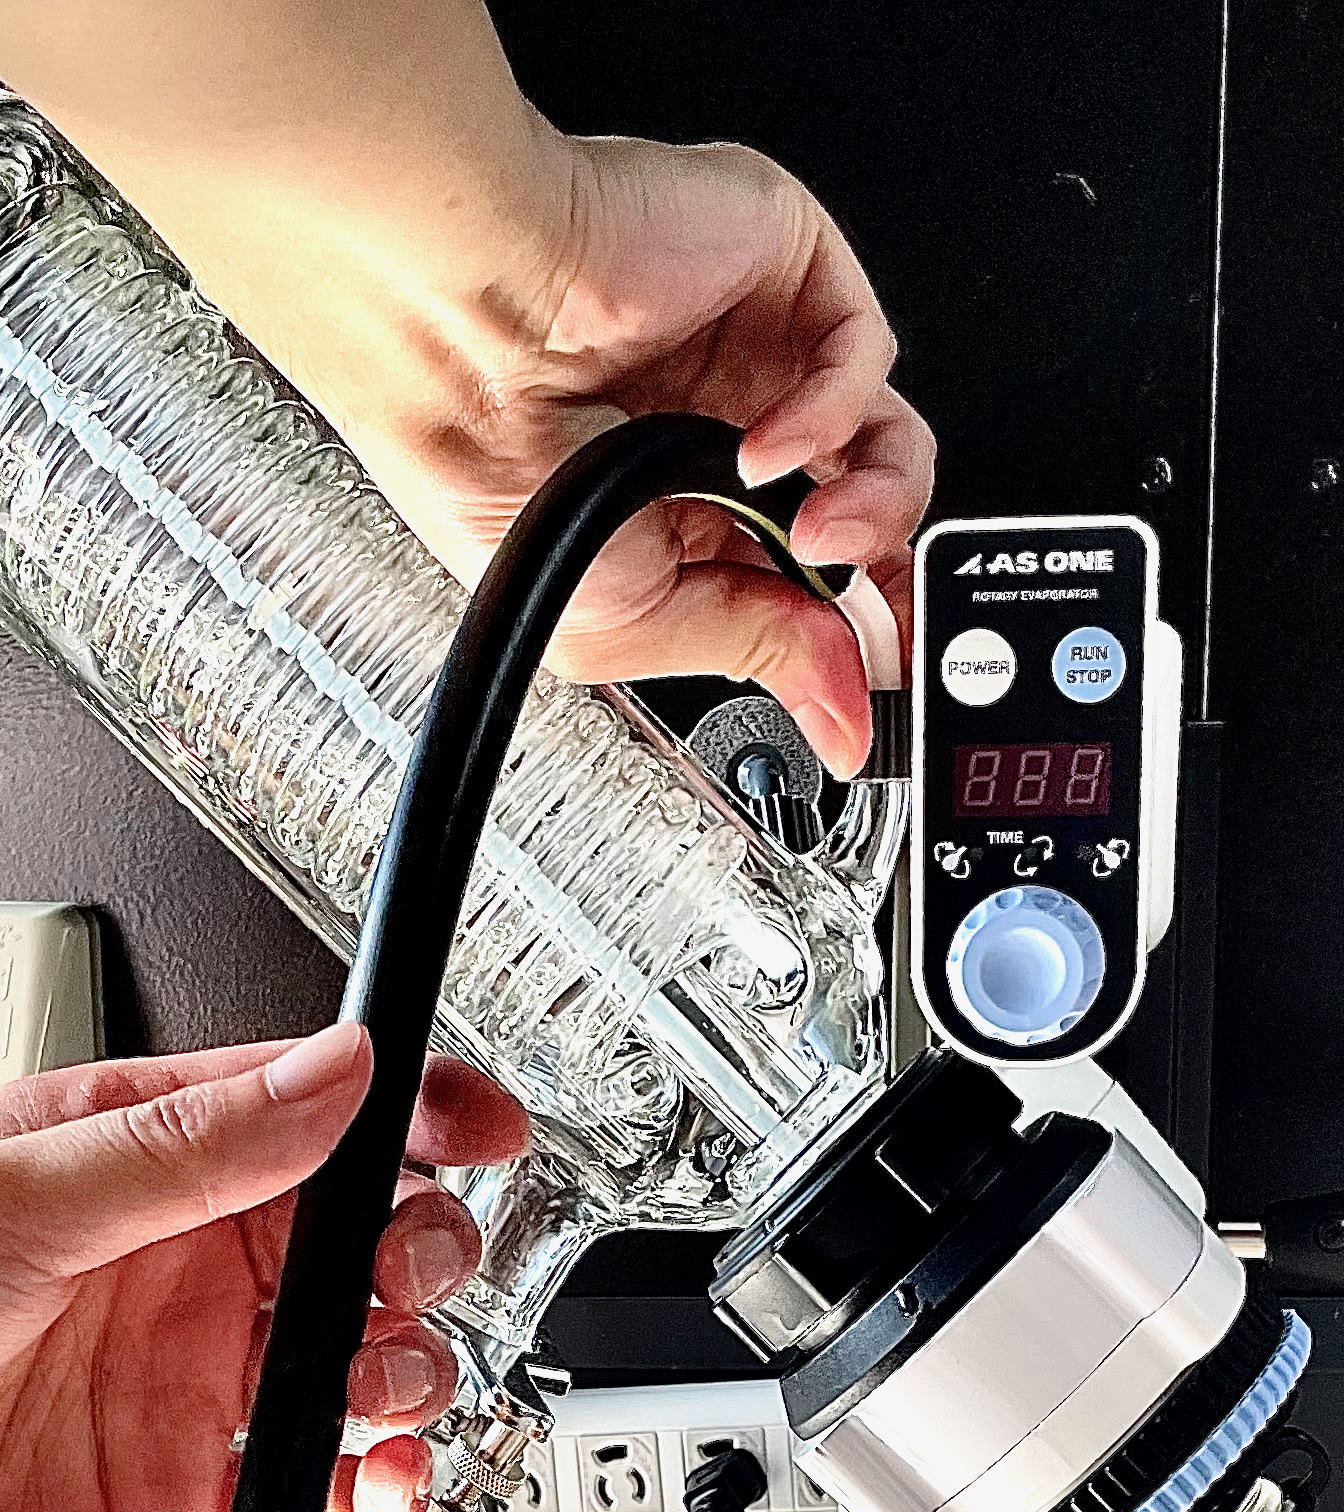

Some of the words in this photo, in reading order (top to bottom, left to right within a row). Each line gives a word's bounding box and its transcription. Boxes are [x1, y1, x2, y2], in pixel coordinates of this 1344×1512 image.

[1044, 550, 1114, 573] ONE
[972, 591, 1018, 602] ROTARY
[1020, 588, 1099, 601] EVAPORATOR
[1071, 646, 1109, 660] RUN
[948, 660, 1011, 675] POWER
[1066, 669, 1112, 683] STOP
[986, 831, 1024, 844] TIME
